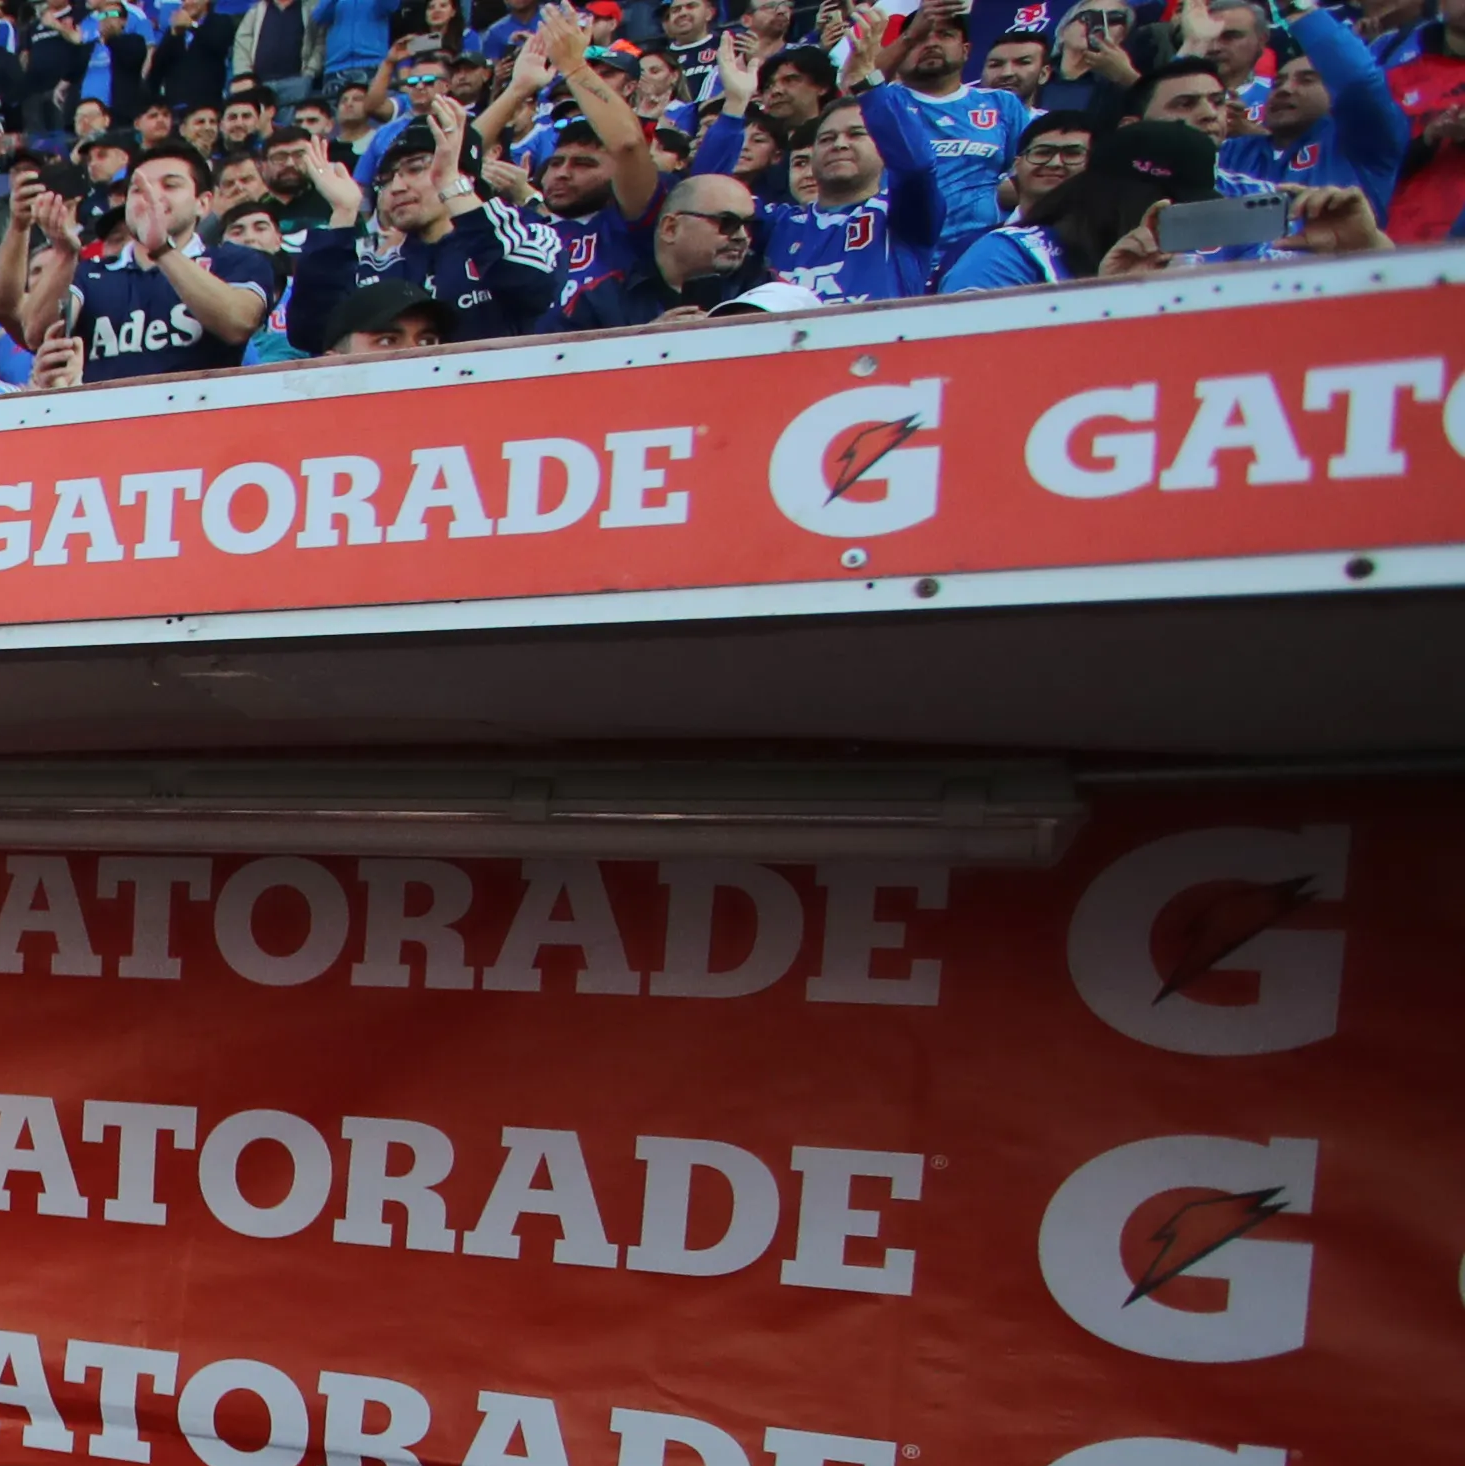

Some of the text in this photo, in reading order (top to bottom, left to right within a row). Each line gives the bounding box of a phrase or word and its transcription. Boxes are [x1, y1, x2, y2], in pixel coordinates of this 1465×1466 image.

[89, 303, 203, 360] AdeS
[769, 377, 943, 538] G
[1024, 356, 1465, 499] GAT
[1067, 822, 1351, 1058] G
[1037, 1133, 1319, 1364] G
